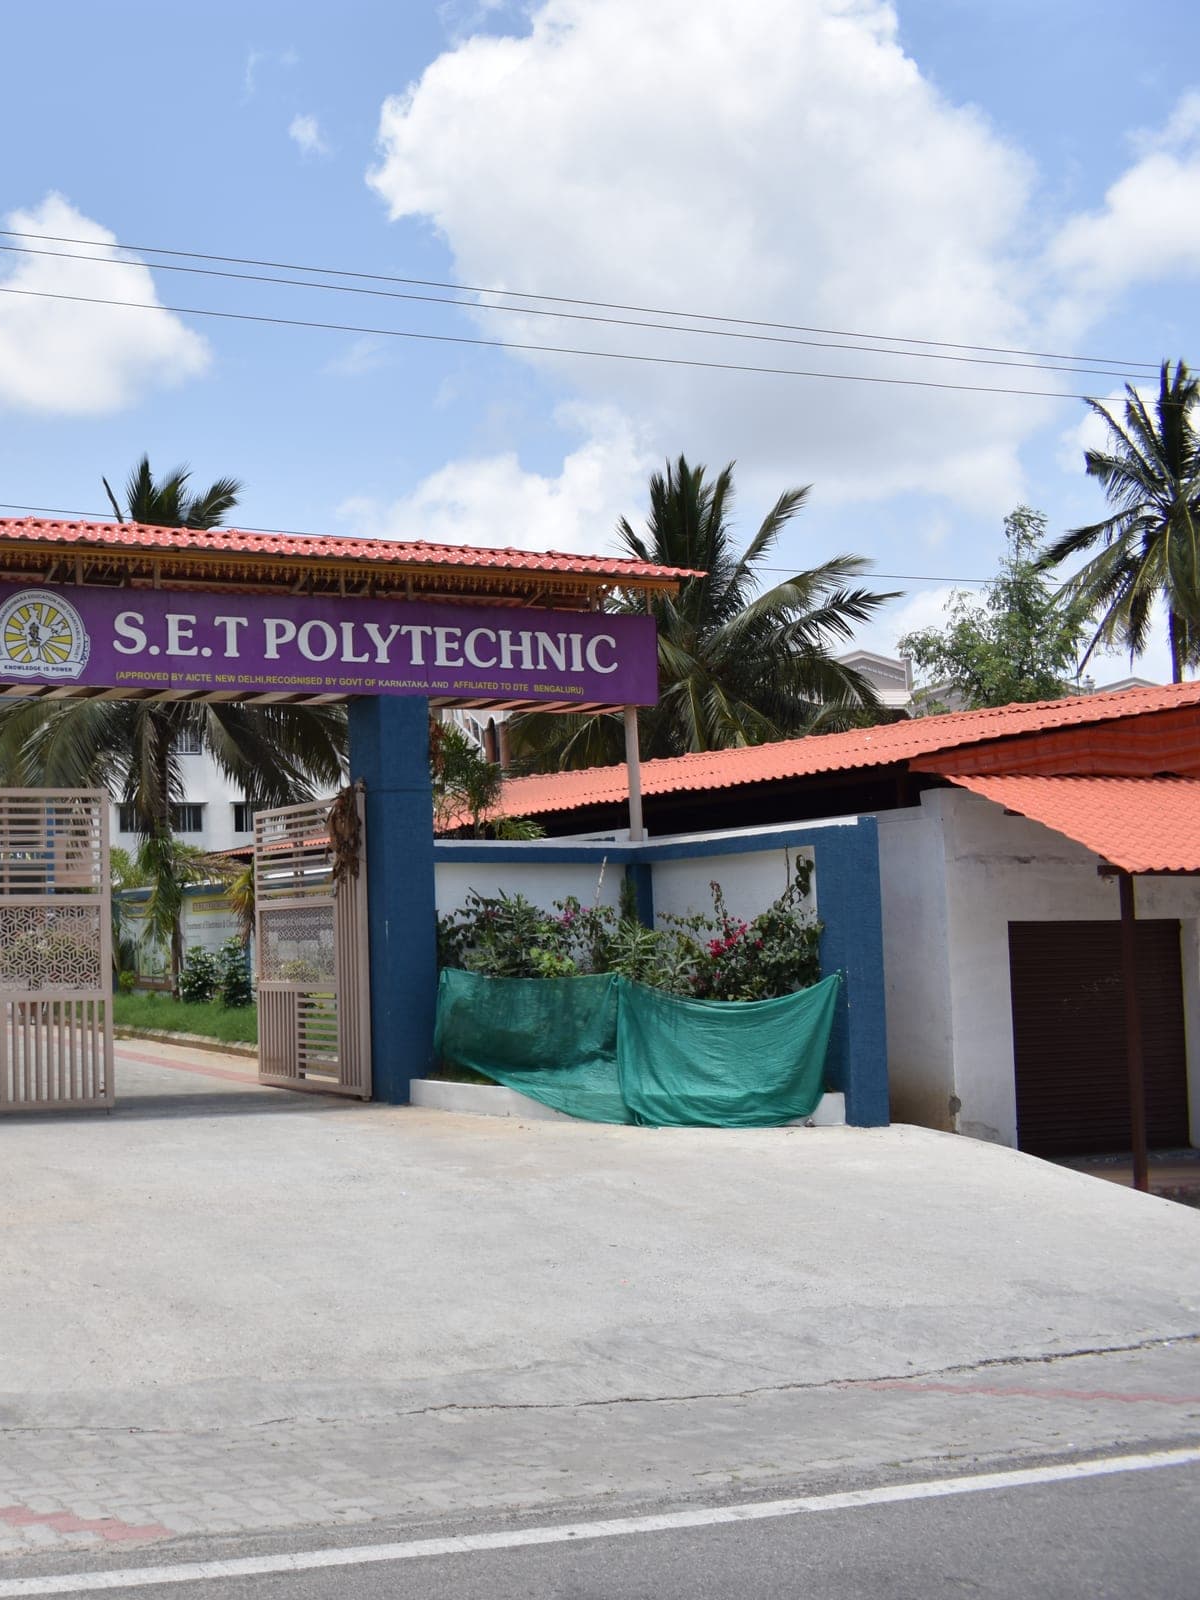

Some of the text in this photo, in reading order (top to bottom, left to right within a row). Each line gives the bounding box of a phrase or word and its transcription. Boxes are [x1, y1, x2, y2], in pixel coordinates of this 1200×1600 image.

[112, 611, 618, 674] S.E.T POLYTECHNIC
[4, 664, 41, 672] KNOWLEDGE
[115, 671, 170, 682] (APPROVED
[171, 673, 184, 682] BY
[186, 673, 213, 682] AICTE
[215, 674, 236, 683] NEW
[325, 678, 337, 686] BY
[339, 677, 363, 687] GOVT
[365, 678, 377, 687] OF
[378, 679, 430, 689] KARNATAKA
[431, 681, 449, 690] AND
[453, 681, 499, 691] AFFILIATED
[501, 682, 511, 691] TO
[513, 683, 529, 692] DTE
[533, 684, 585, 696] BENGALURU)
